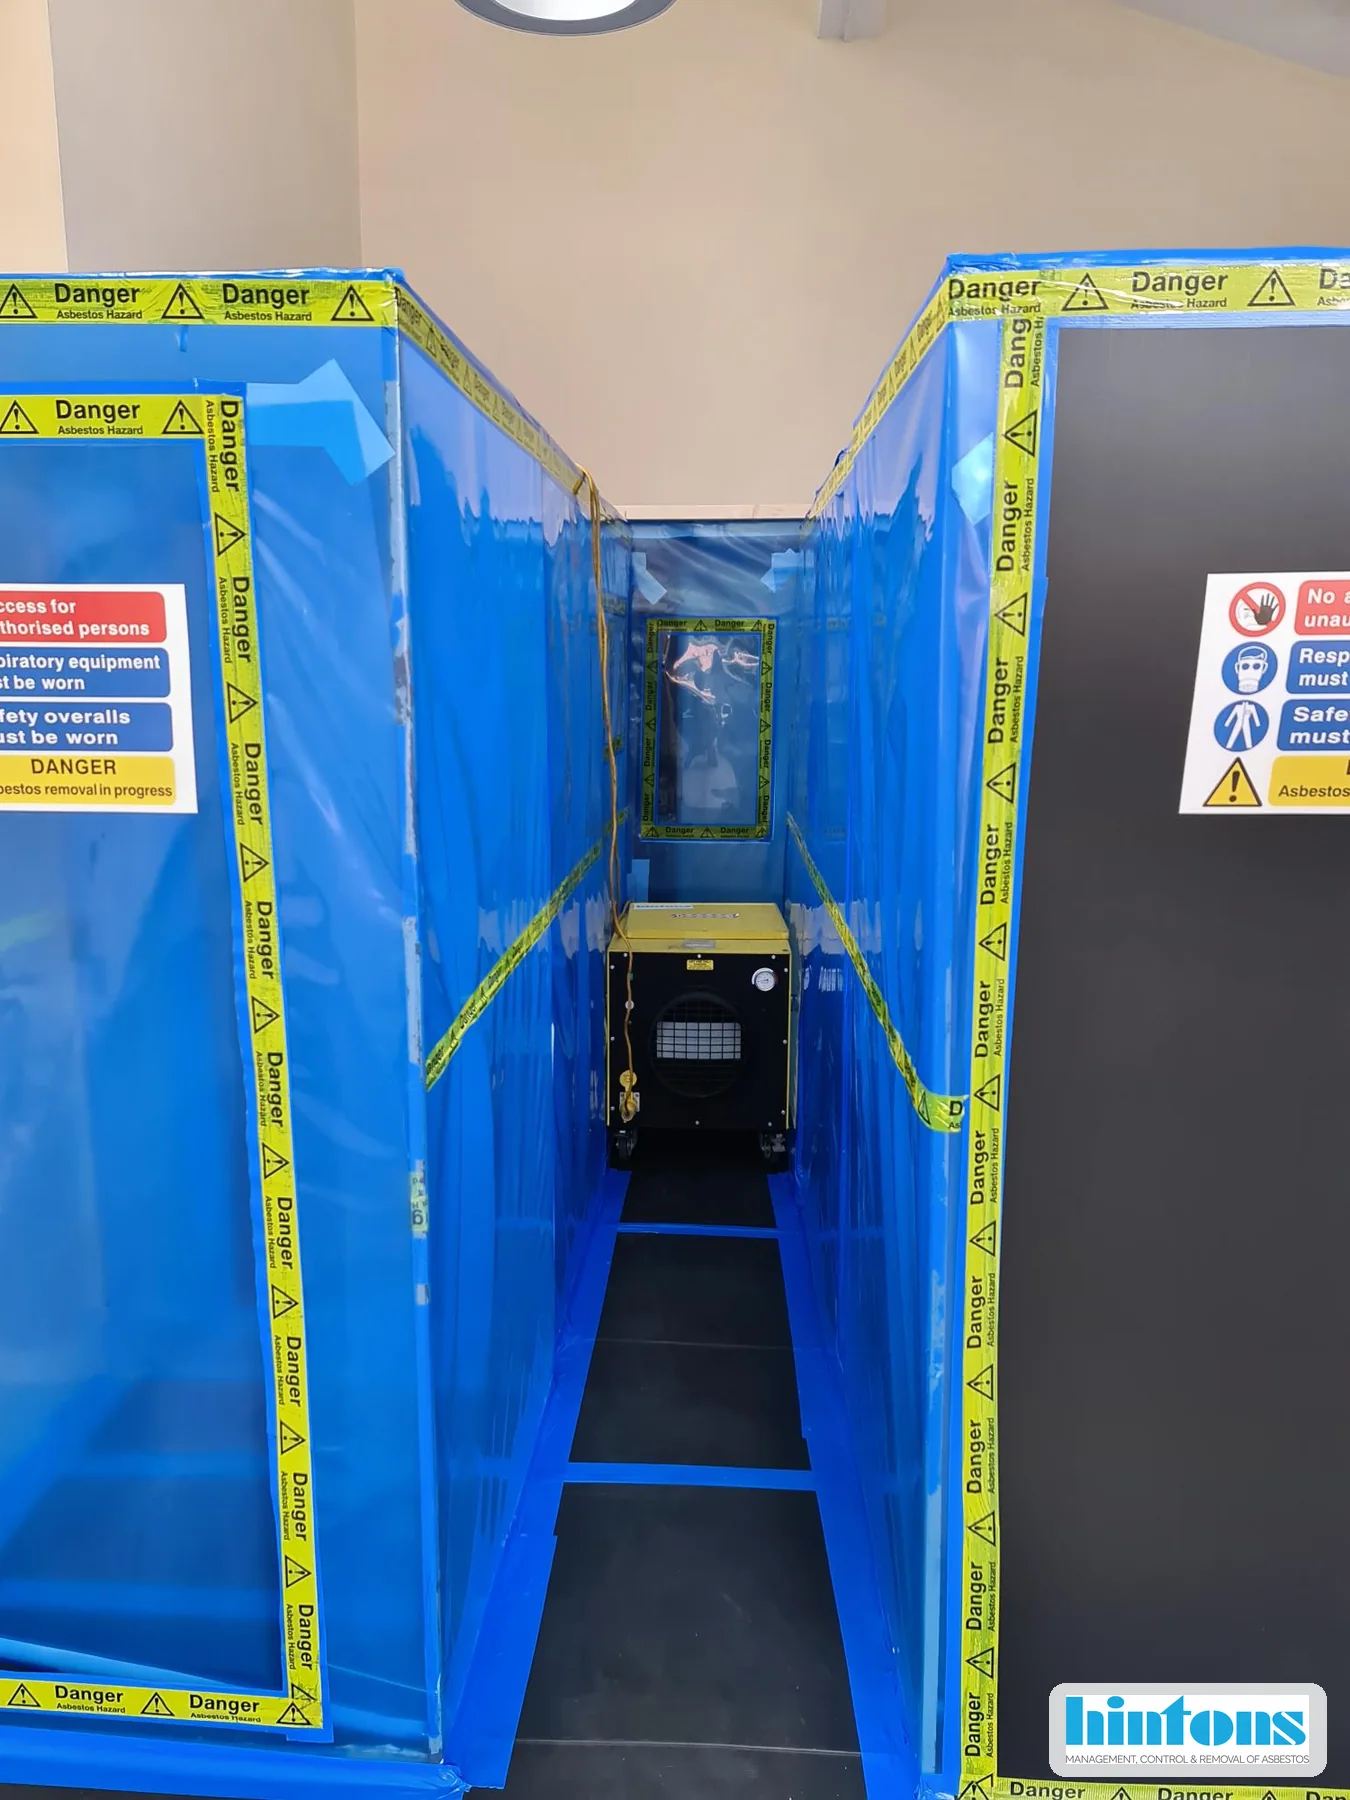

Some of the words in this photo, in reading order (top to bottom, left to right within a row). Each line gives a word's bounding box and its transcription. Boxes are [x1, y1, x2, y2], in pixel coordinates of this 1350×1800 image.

[54, 283, 140, 308] Danger
[222, 283, 309, 308] Danger
[948, 279, 1042, 302] Danger
[1132, 271, 1228, 296] Danger
[56, 309, 104, 319] Asbestos
[106, 309, 142, 319] Hazard
[224, 310, 272, 320] Asbestos
[275, 311, 312, 321] Hazard
[1001, 302, 1041, 314] Hazard
[1187, 297, 1227, 308] Hazard
[1030, 335, 1043, 387] Asbestos
[56, 400, 140, 424] Danger
[206, 400, 216, 451] Asbestos
[58, 425, 105, 435] Asbestos
[107, 425, 143, 435] Hazard
[219, 401, 239, 492] Danger
[209, 454, 220, 493] Hazard
[1023, 478, 1034, 517] Hazard
[996, 481, 1022, 572] Danger
[1021, 520, 1032, 572] Asbestos
[50, 599, 76, 613] for
[219, 576, 229, 625] Asbestos
[1307, 588, 1336, 604] No
[79, 623, 150, 638] persons
[232, 577, 251, 663] Danger
[714, 619, 745, 628] Danger
[222, 627, 233, 663] Hazard
[1299, 648, 1350, 667] Resp
[69, 654, 160, 672] equipment
[1012, 656, 1024, 694] Hazard
[1298, 671, 1348, 686] must
[14, 675, 36, 689] be
[41, 678, 85, 690] worn
[765, 682, 773, 712] Danger
[44, 709, 131, 724] overalls
[987, 656, 1011, 744] Danger
[1293, 706, 1350, 722] Safe
[31, 729, 58, 744] be
[66, 732, 118, 745] worn
[1009, 698, 1021, 743] Asbestos
[1289, 729, 1350, 744] must
[31, 758, 117, 775] DANGER
[231, 742, 241, 788] Asbestos
[764, 739, 772, 769] Danger
[44, 783, 98, 796] removal
[99, 783, 112, 796] in
[114, 784, 173, 799] progress
[244, 743, 263, 825] Danger
[1278, 785, 1350, 797] Asbestos
[235, 791, 245, 825] Hazard
[1002, 822, 1014, 856] Hazard
[980, 824, 1002, 905] Danger
[1000, 859, 1012, 904] Asbestos
[245, 900, 254, 944] Asbestos
[256, 901, 274, 979] Danger
[247, 946, 257, 979] Hazard
[995, 979, 1005, 1012] Hazard
[974, 980, 994, 1058] Danger
[993, 1014, 1003, 1057] Asbestos
[256, 1051, 265, 1092] Asbestos
[266, 1052, 283, 1127] Danger
[259, 1094, 267, 1127] Hazard
[990, 1128, 999, 1160] Hazard
[970, 1130, 989, 1205] Danger
[989, 1162, 998, 1204] Asbestos
[265, 1195, 274, 1236] Asbestos
[276, 1197, 293, 1269] Danger
[268, 1238, 277, 1269] Hazard
[987, 1273, 996, 1304] Hazard
[966, 1276, 986, 1349] Danger
[987, 1306, 996, 1347] Asbestos
[274, 1335, 282, 1373] Asbestos
[285, 1336, 301, 1407] Danger
[277, 1375, 285, 1405] Hazard
[987, 1418, 995, 1450] Hazard
[966, 1419, 986, 1494] Danger
[987, 1452, 995, 1495] Asbestos
[291, 1472, 308, 1541] Danger
[988, 1561, 996, 1592] Hazard
[966, 1562, 987, 1631] Danger
[286, 1603, 294, 1640] Asbestos
[988, 1595, 996, 1632] Asbestos
[297, 1604, 314, 1670] Danger
[288, 1642, 296, 1670] Hazard
[55, 1685, 123, 1703] Danger
[56, 1703, 94, 1711] Asbestos
[96, 1705, 126, 1713] Hazard
[190, 1694, 260, 1713] Danger
[986, 1693, 994, 1720] Hazard
[190, 1712, 229, 1720] Asbestos
[965, 1692, 984, 1757] Danger
[986, 1722, 994, 1758] Asbestos
[1010, 1781, 1086, 1800] Danger
